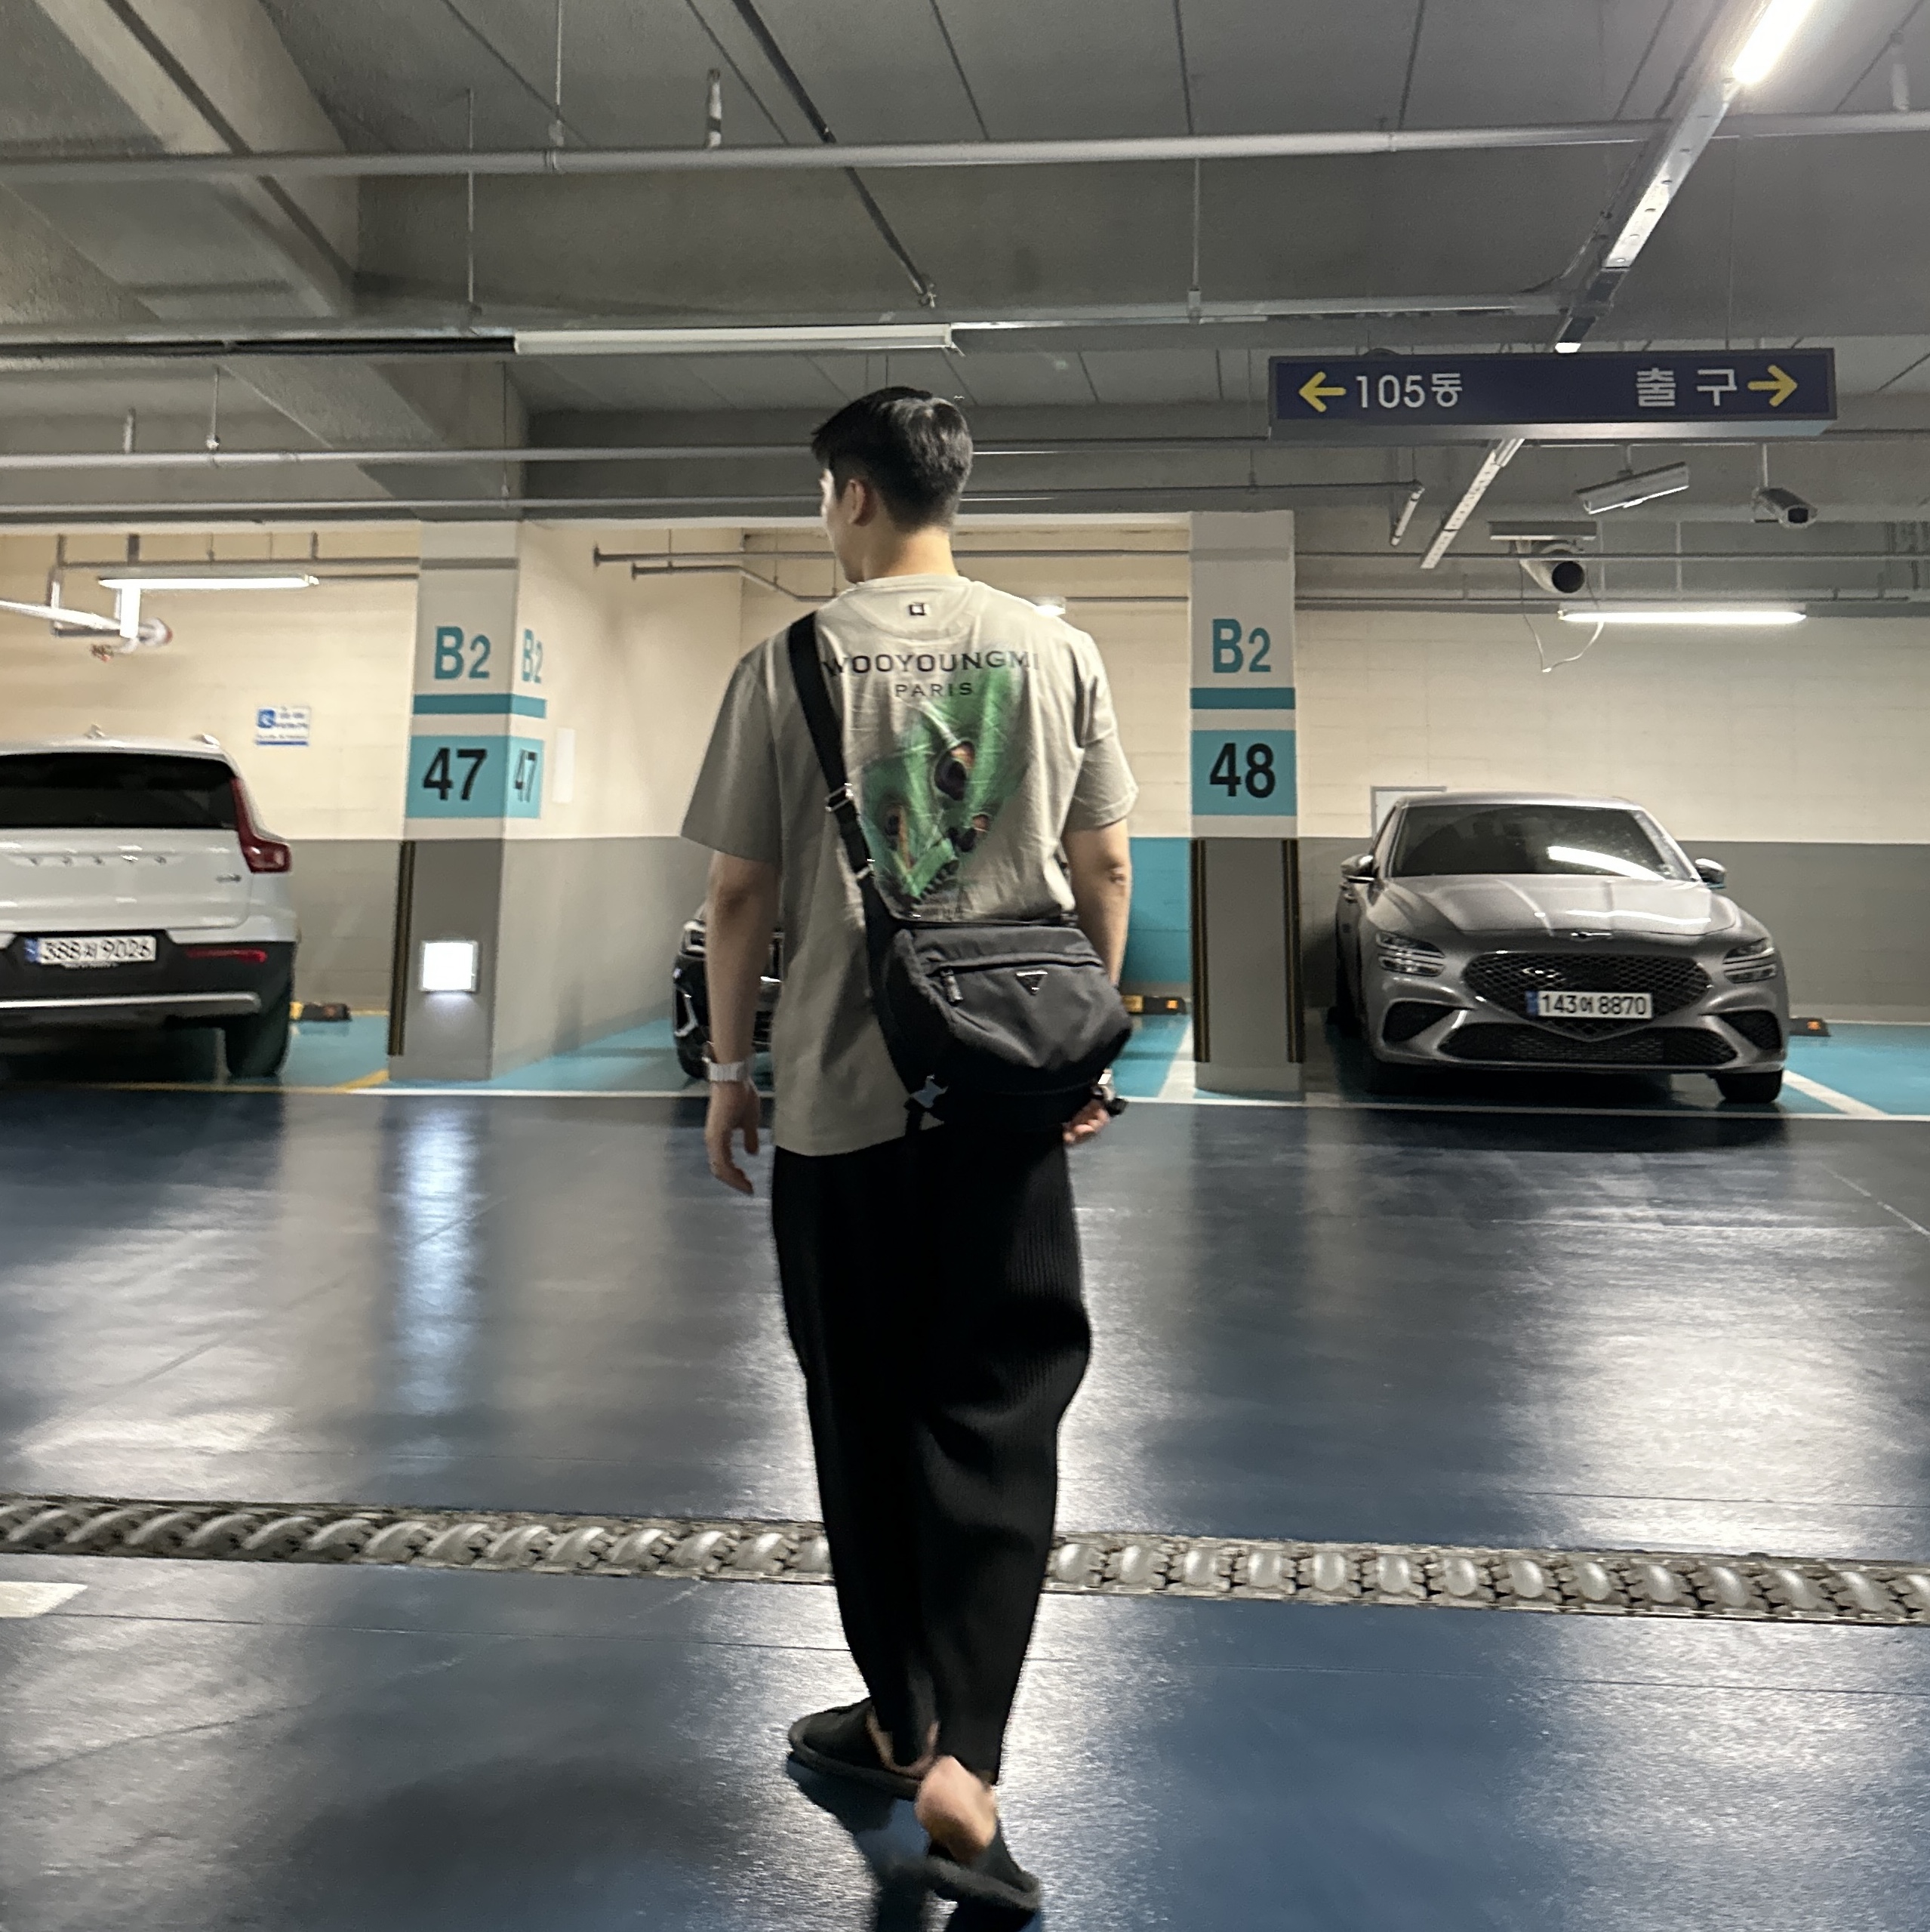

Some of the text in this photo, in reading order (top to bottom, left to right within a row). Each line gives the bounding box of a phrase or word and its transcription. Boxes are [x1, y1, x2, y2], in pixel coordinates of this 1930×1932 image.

[1356, 373, 1463, 408] 105동
[434, 625, 491, 680] B2
[522, 628, 543, 684] B2
[821, 650, 1039, 676] WOOYOUNGMI
[1211, 618, 1272, 673] B2
[895, 683, 973, 697] PARIS
[423, 747, 488, 801] 47
[514, 748, 537, 803] 47
[1209, 742, 1276, 799] 48
[1598, 995, 1647, 1015] 8870
